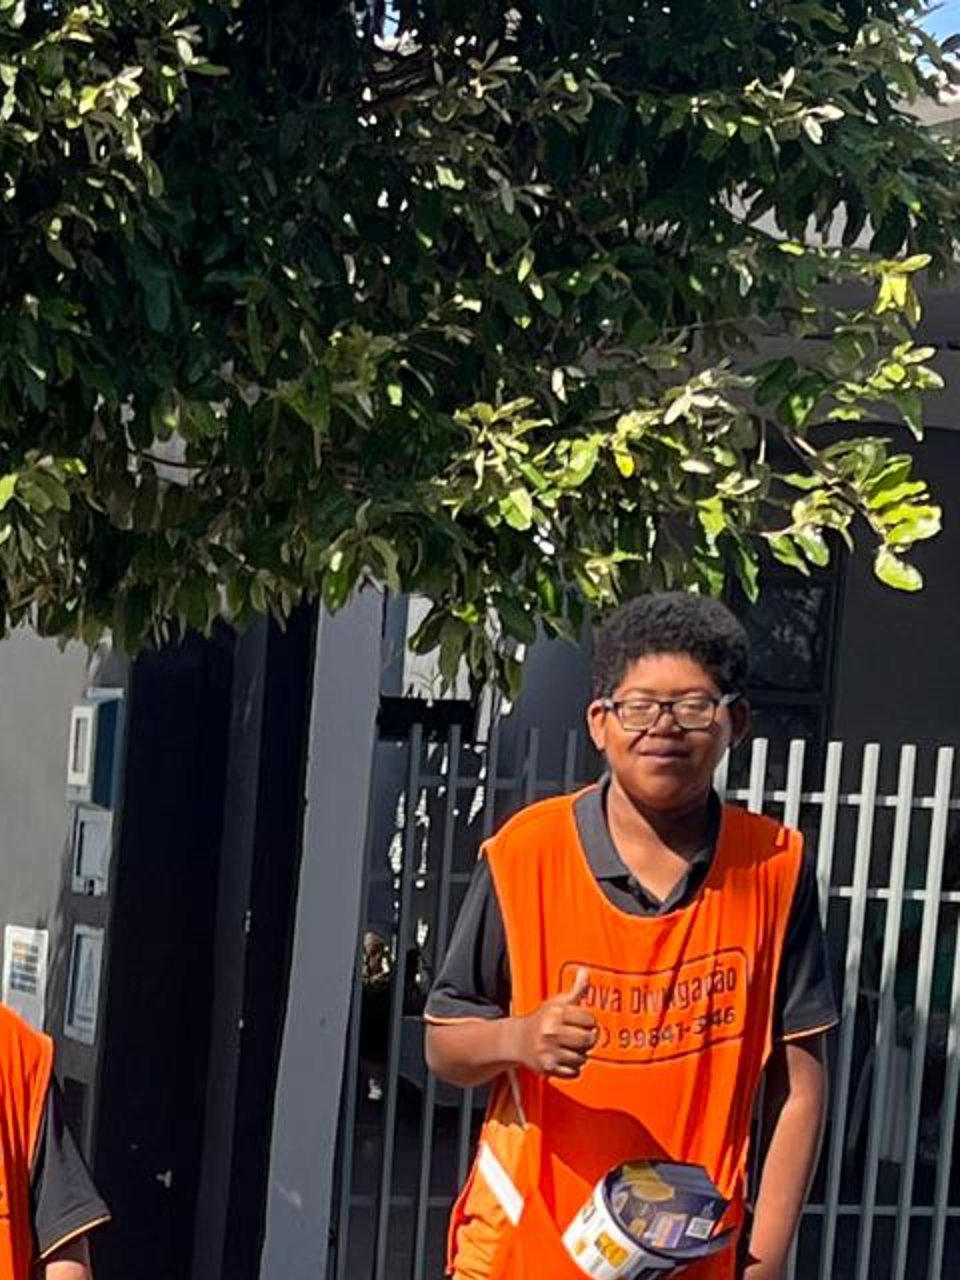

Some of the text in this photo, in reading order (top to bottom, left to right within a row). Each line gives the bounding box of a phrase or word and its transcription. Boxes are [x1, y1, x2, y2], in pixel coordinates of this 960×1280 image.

[580, 964, 737, 1014] ova Divgaão
[618, 1006, 736, 1050] 99841-346
